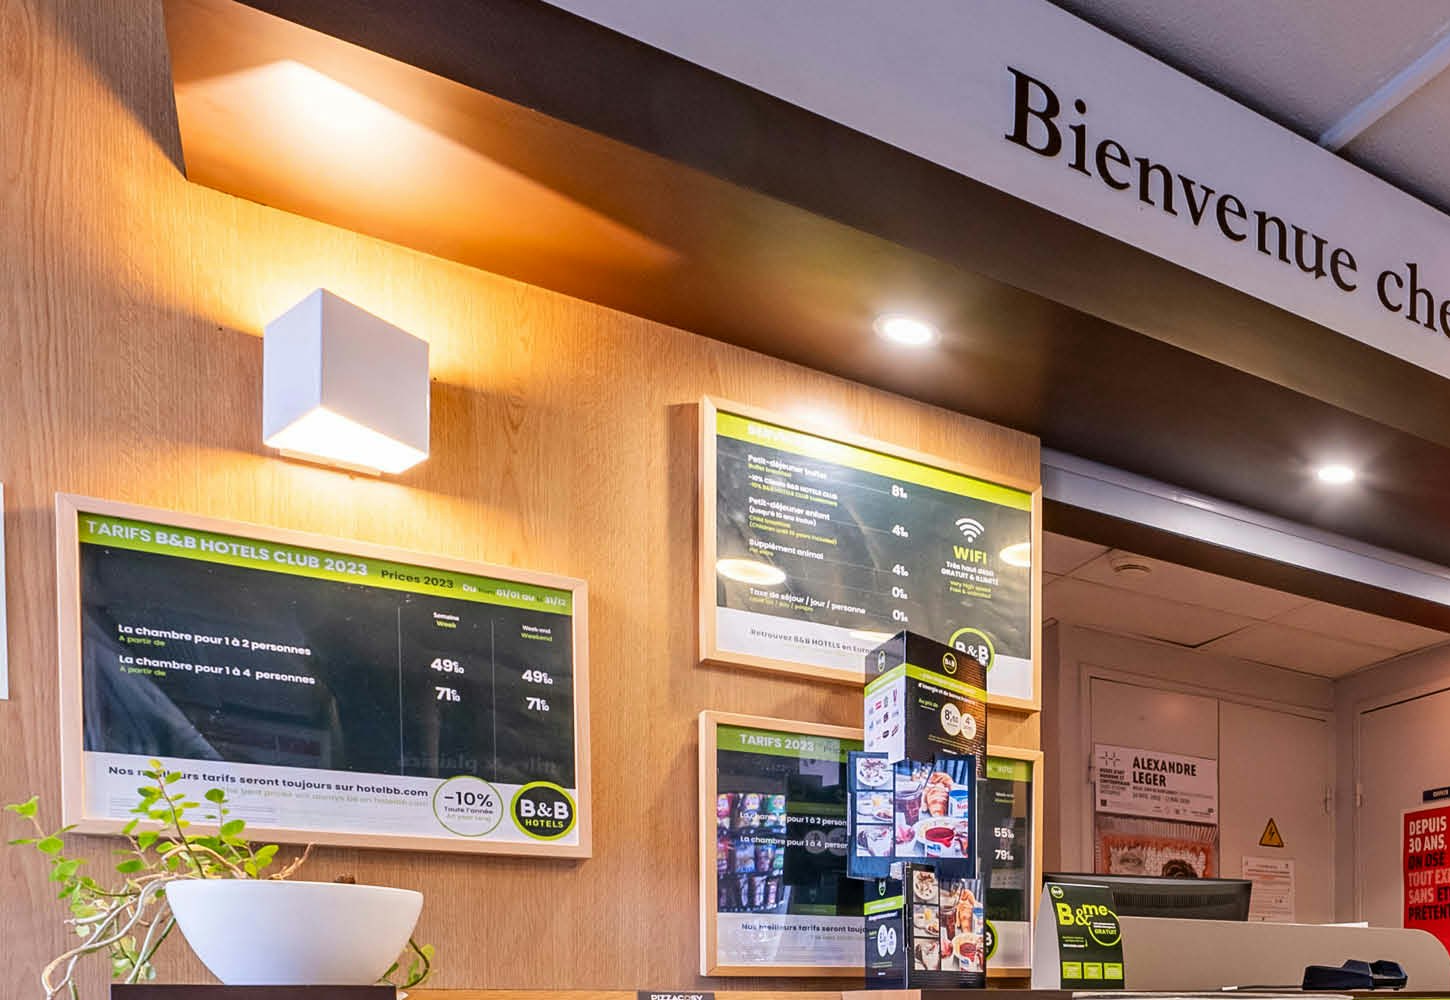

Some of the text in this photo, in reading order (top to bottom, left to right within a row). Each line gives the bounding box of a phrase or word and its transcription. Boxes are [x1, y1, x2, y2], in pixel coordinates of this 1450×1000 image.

[1004, 65, 1358, 292] Bienvenue
[87, 519, 151, 543] TARIFS
[155, 532, 197, 549] B&B
[200, 538, 270, 561] HOTELS
[274, 550, 320, 569] CLUB
[324, 558, 368, 576] 2023
[381, 569, 421, 584] Prices
[424, 575, 454, 589] 2023
[953, 545, 988, 565] WIFI
[118, 624, 312, 656] La chambre pour 1 à 2 personnes
[811, 638, 841, 649] HOTELS
[119, 654, 316, 686] La chambre pour 1 à 4 personnes
[740, 734, 782, 748] TARIFS
[784, 739, 815, 752] 2023
[1132, 755, 1197, 777] ALEXANDRE
[109, 766, 134, 777] Nos
[202, 772, 236, 785] tarifs
[239, 776, 279, 787] seront
[281, 778, 332, 793] toujours
[335, 783, 355, 793] sur
[356, 784, 429, 798] hotelbb.com
[1132, 771, 1167, 788] LEGER
[444, 791, 494, 808] -10%
[520, 798, 570, 820] B&B
[525, 818, 564, 829] HOTELS
[786, 816, 805, 825] pour
[1409, 816, 1448, 836] DEPUIS
[751, 836, 786, 846] chambre
[786, 839, 805, 849] pour
[1408, 834, 1448, 854] 30 ANS,
[1408, 852, 1446, 870] ON OSE
[1408, 870, 1434, 887] TOUT
[1408, 887, 1435, 904] SANS
